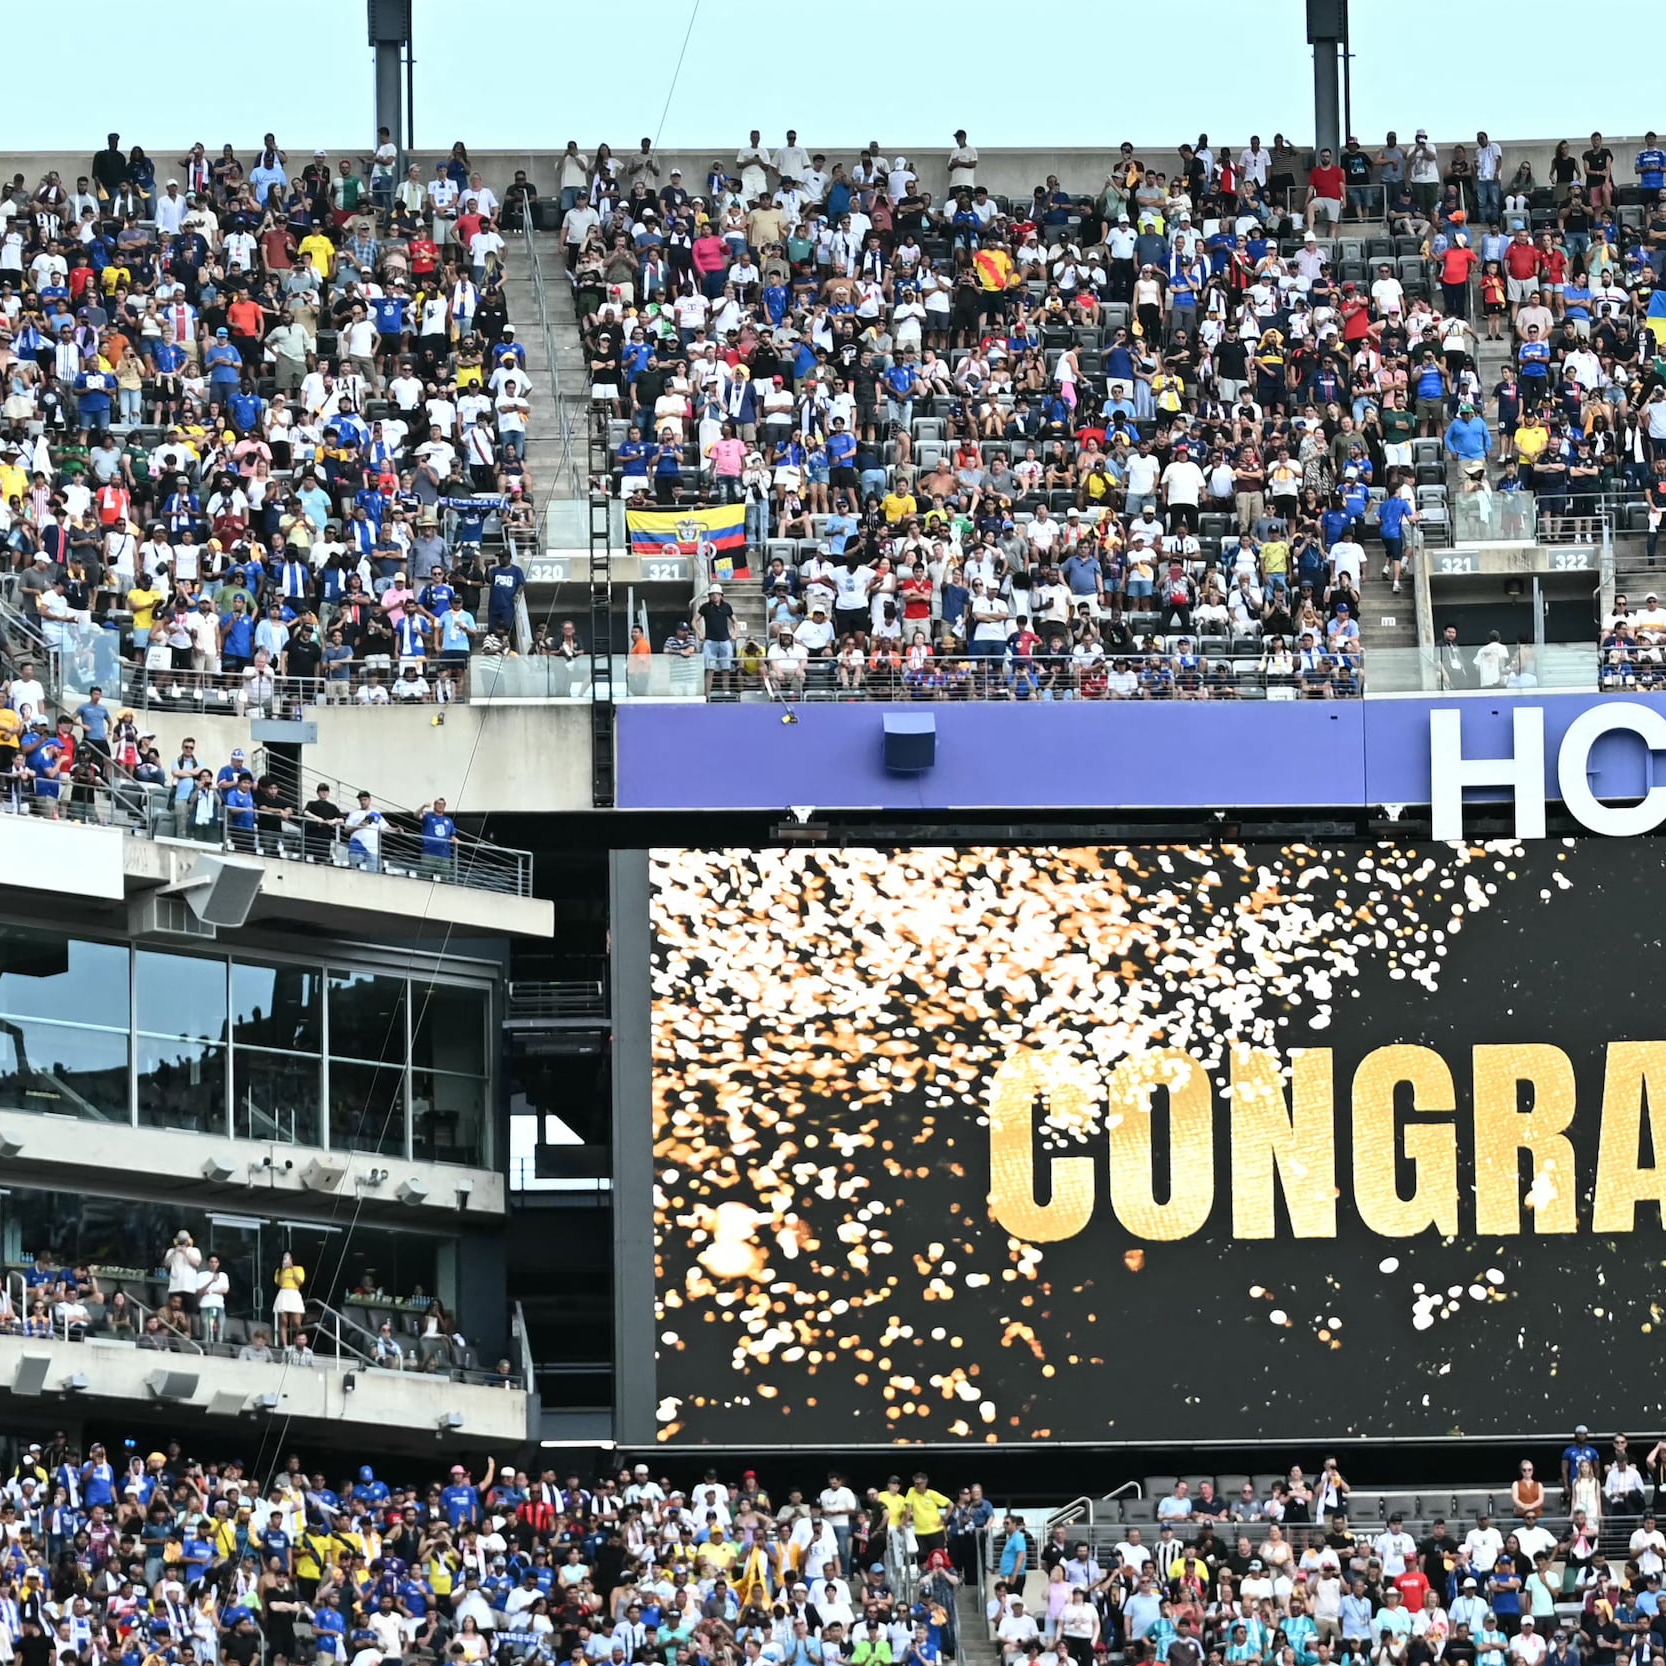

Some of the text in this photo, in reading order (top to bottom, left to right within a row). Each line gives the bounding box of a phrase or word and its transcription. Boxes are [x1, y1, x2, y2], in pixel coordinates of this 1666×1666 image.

[1441, 556, 1472, 574] 321
[1555, 553, 1588, 570] 322
[530, 564, 564, 581] 320
[649, 562, 680, 580] 321
